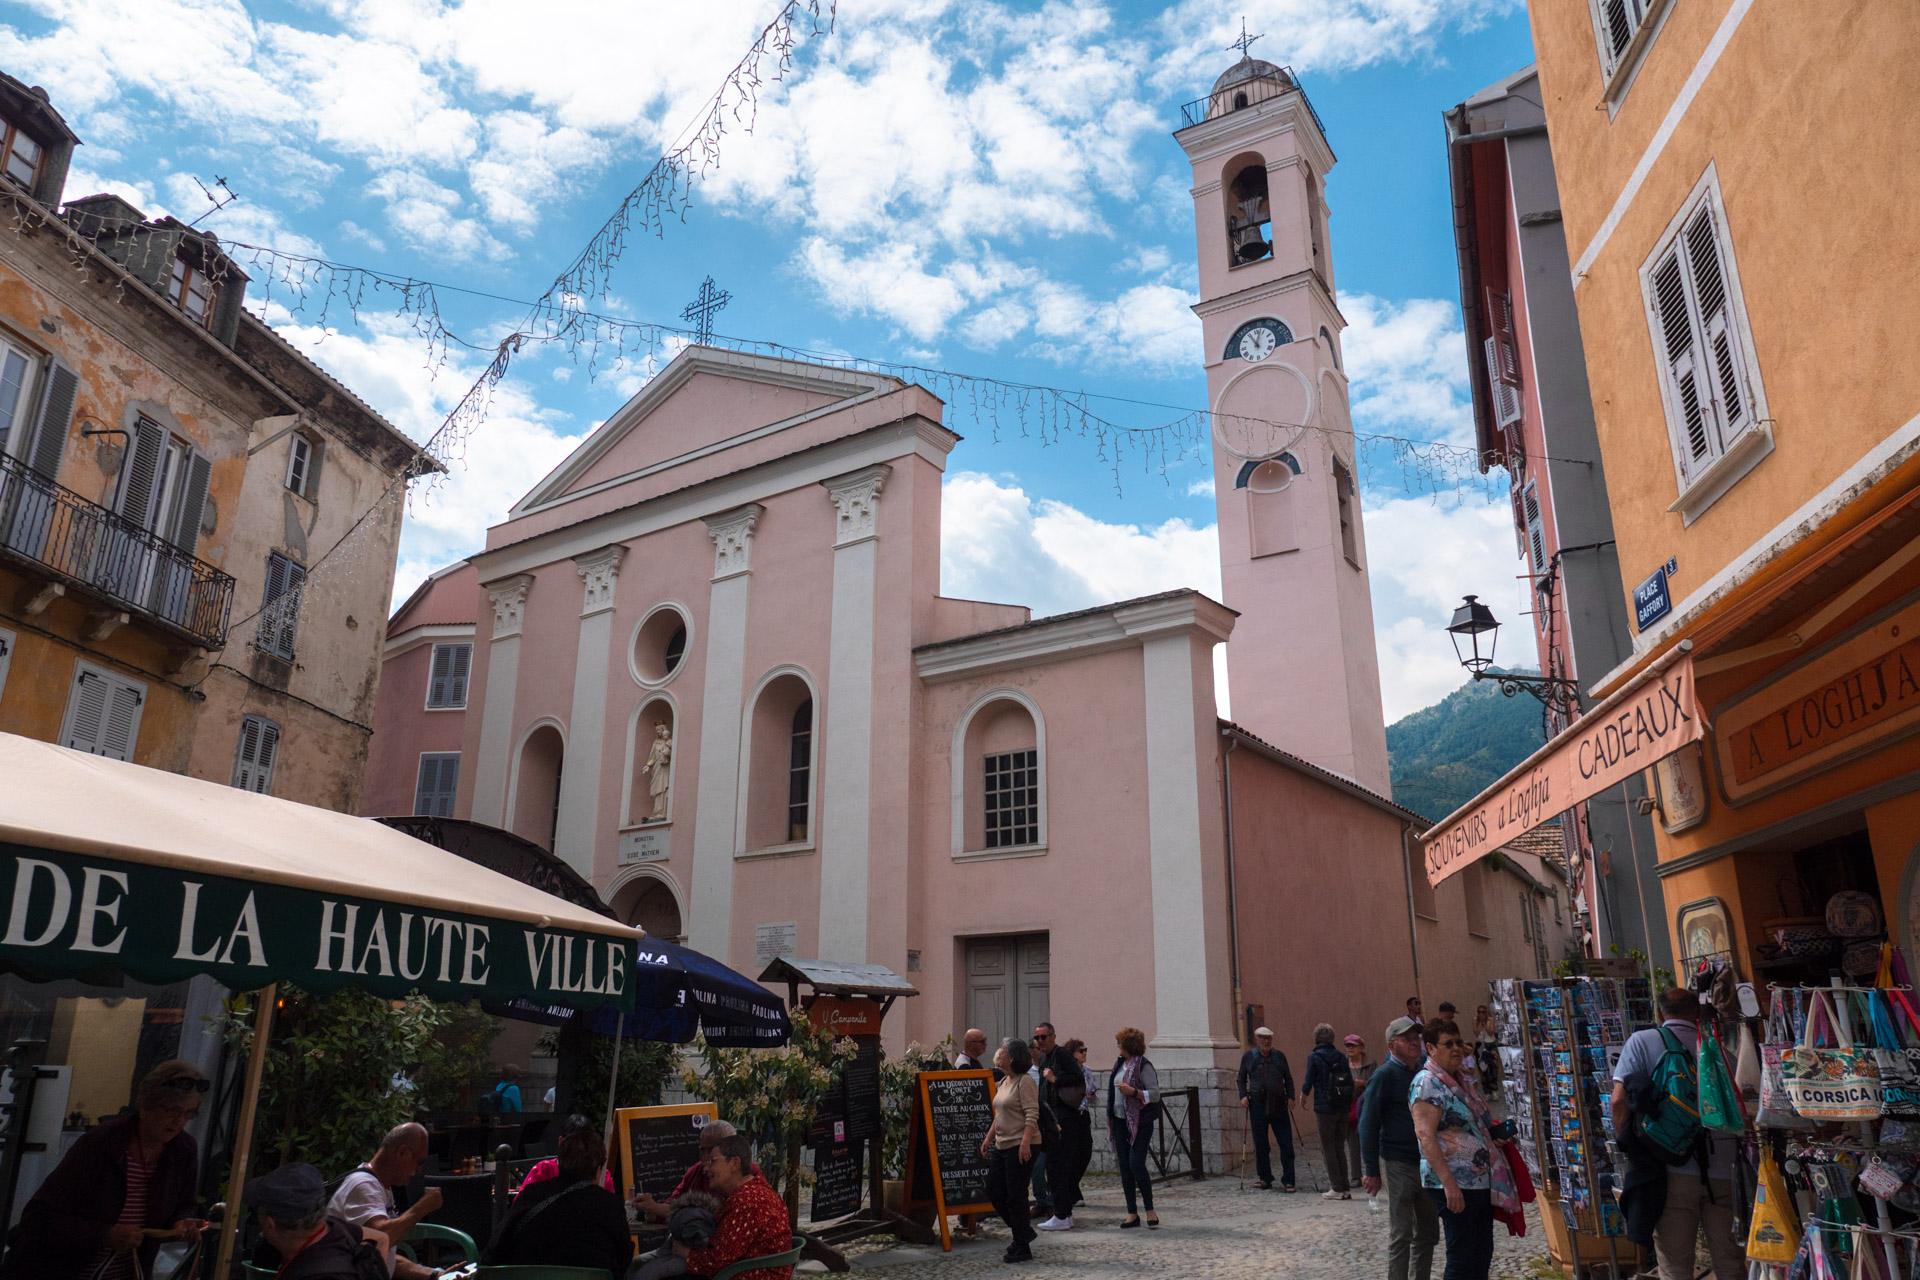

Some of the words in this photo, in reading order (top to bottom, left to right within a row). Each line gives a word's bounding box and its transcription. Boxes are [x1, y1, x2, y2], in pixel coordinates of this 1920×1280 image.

[1640, 580, 1658, 603] PLACE
[1638, 594, 1664, 622] GAFFORY
[1748, 729, 1765, 770] A
[1780, 653, 1920, 750] LOGHJA
[1428, 810, 1488, 875] SOUVENIRS
[1508, 767, 1550, 829] Loghja
[1578, 676, 1691, 780] CADEAUX
[0, 856, 129, 954] DE
[172, 881, 268, 967] LA
[314, 900, 490, 986] HAUTE
[524, 930, 626, 996] VILLE
[751, 1004, 782, 1020] PAOLINA
[1802, 1087, 1871, 1103] CORSICA
[969, 1104, 990, 1112] CHOIX
[942, 1170, 970, 1179] DESSERT
[972, 1169, 981, 1177] AU
